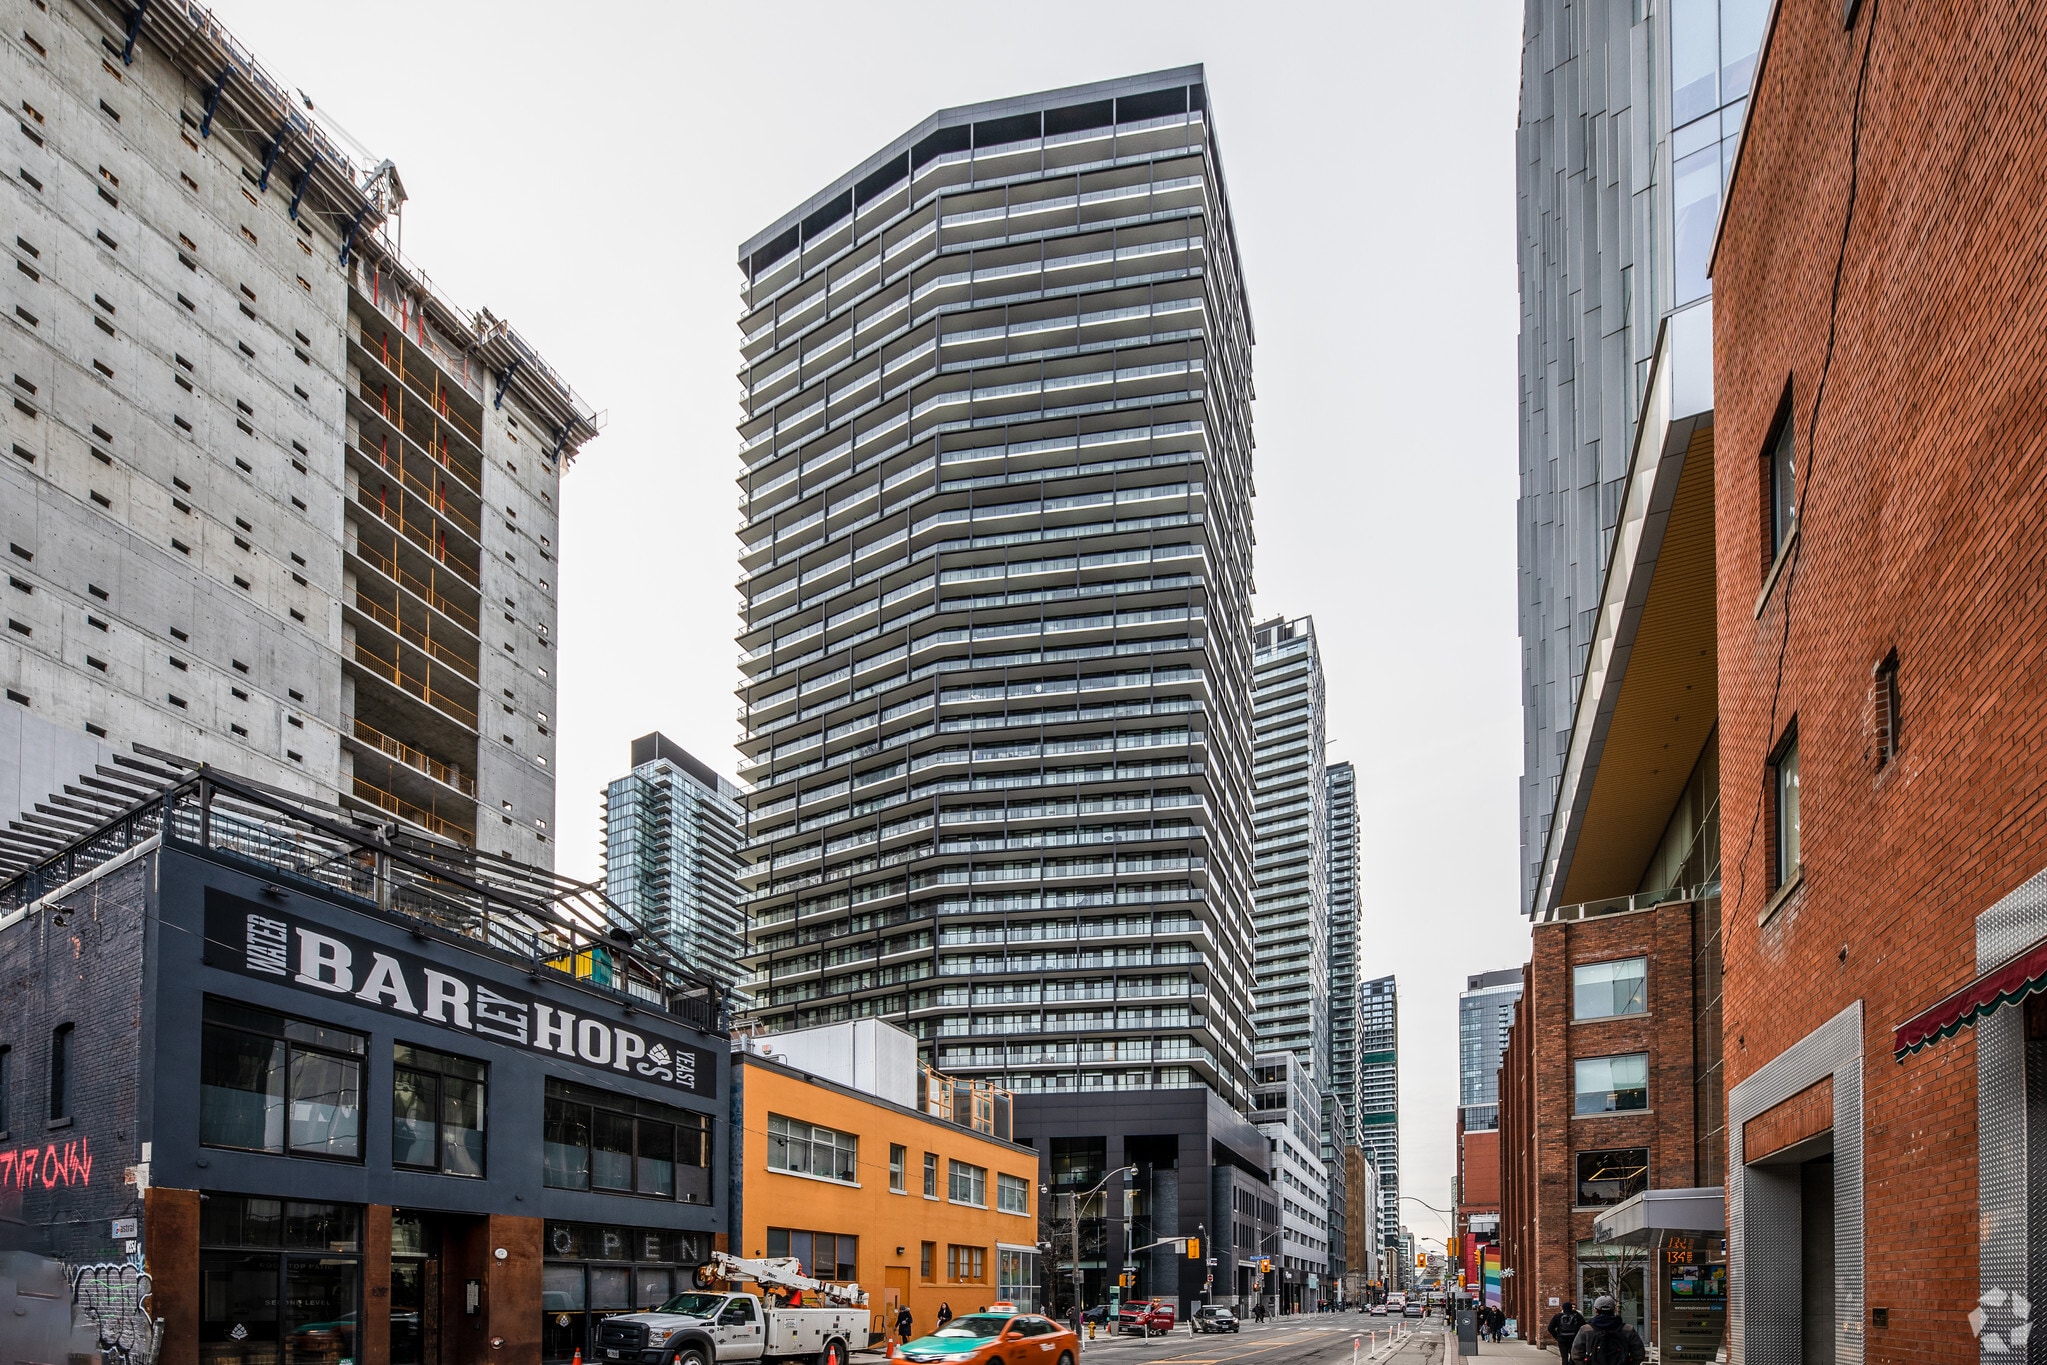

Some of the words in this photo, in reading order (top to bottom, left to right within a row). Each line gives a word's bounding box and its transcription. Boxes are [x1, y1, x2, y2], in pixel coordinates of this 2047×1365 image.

[246, 913, 287, 976] WATER
[295, 926, 473, 1031] BAR
[476, 984, 528, 1045] LEY
[675, 1051, 695, 1089] YEAST
[120, 1223, 135, 1234] astral
[552, 1227, 698, 1260] OPEN
[1666, 1251, 1686, 1264] 134
[259, 1262, 306, 1270] ROOTOP
